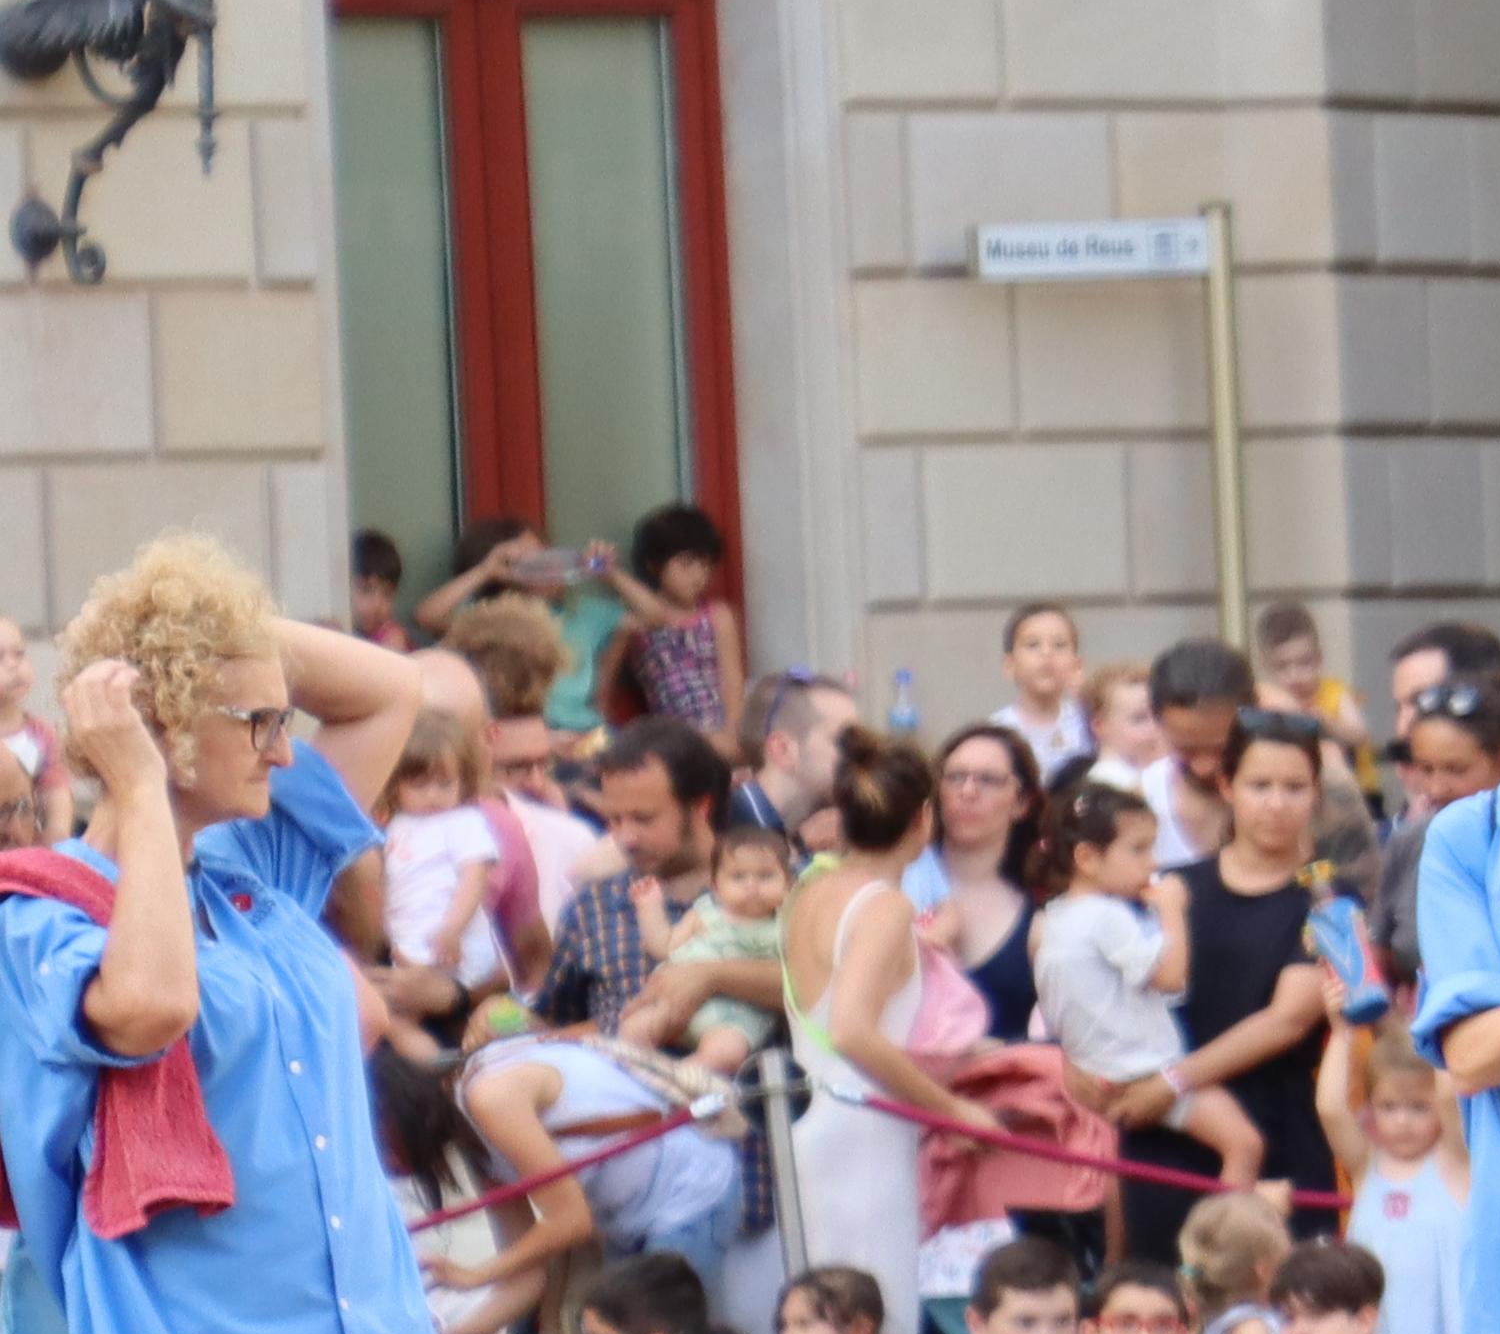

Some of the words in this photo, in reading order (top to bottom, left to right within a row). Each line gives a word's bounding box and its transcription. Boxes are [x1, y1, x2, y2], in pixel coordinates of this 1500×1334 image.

[985, 238, 1050, 260] Museu
[1055, 237, 1080, 259] de
[1085, 233, 1135, 257] Reus
